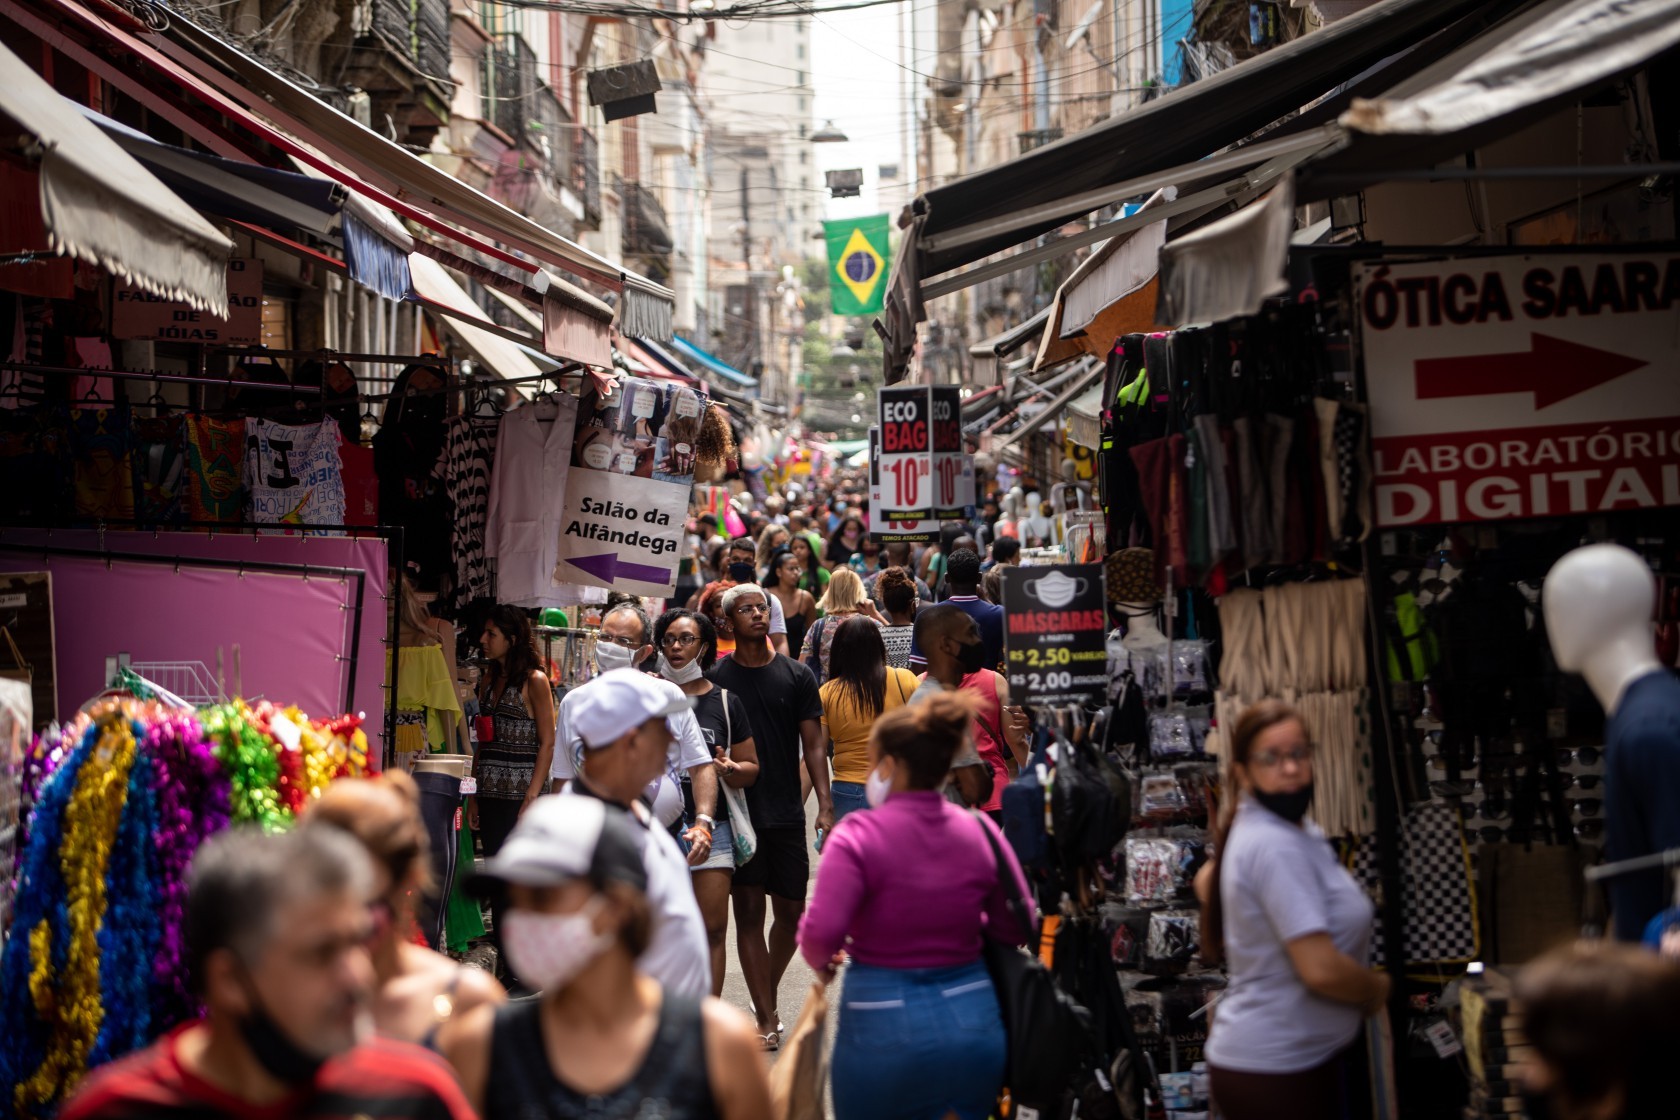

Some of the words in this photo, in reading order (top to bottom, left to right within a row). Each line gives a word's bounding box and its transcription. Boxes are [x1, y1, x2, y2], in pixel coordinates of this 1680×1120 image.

[1364, 264, 1513, 330] ÓTICA
[173, 310, 200, 322] DE
[883, 400, 917, 422] ECO
[884, 420, 927, 451] BAG
[580, 496, 638, 520] Salão
[643, 508, 670, 526] da
[565, 520, 677, 555] Alfândega
[1009, 610, 1104, 632] MÁSCARAS
[1009, 650, 1025, 662] R$
[1026, 647, 1071, 668] 2,50
[1010, 674, 1026, 685] R$
[1027, 671, 1072, 691] 2,00
